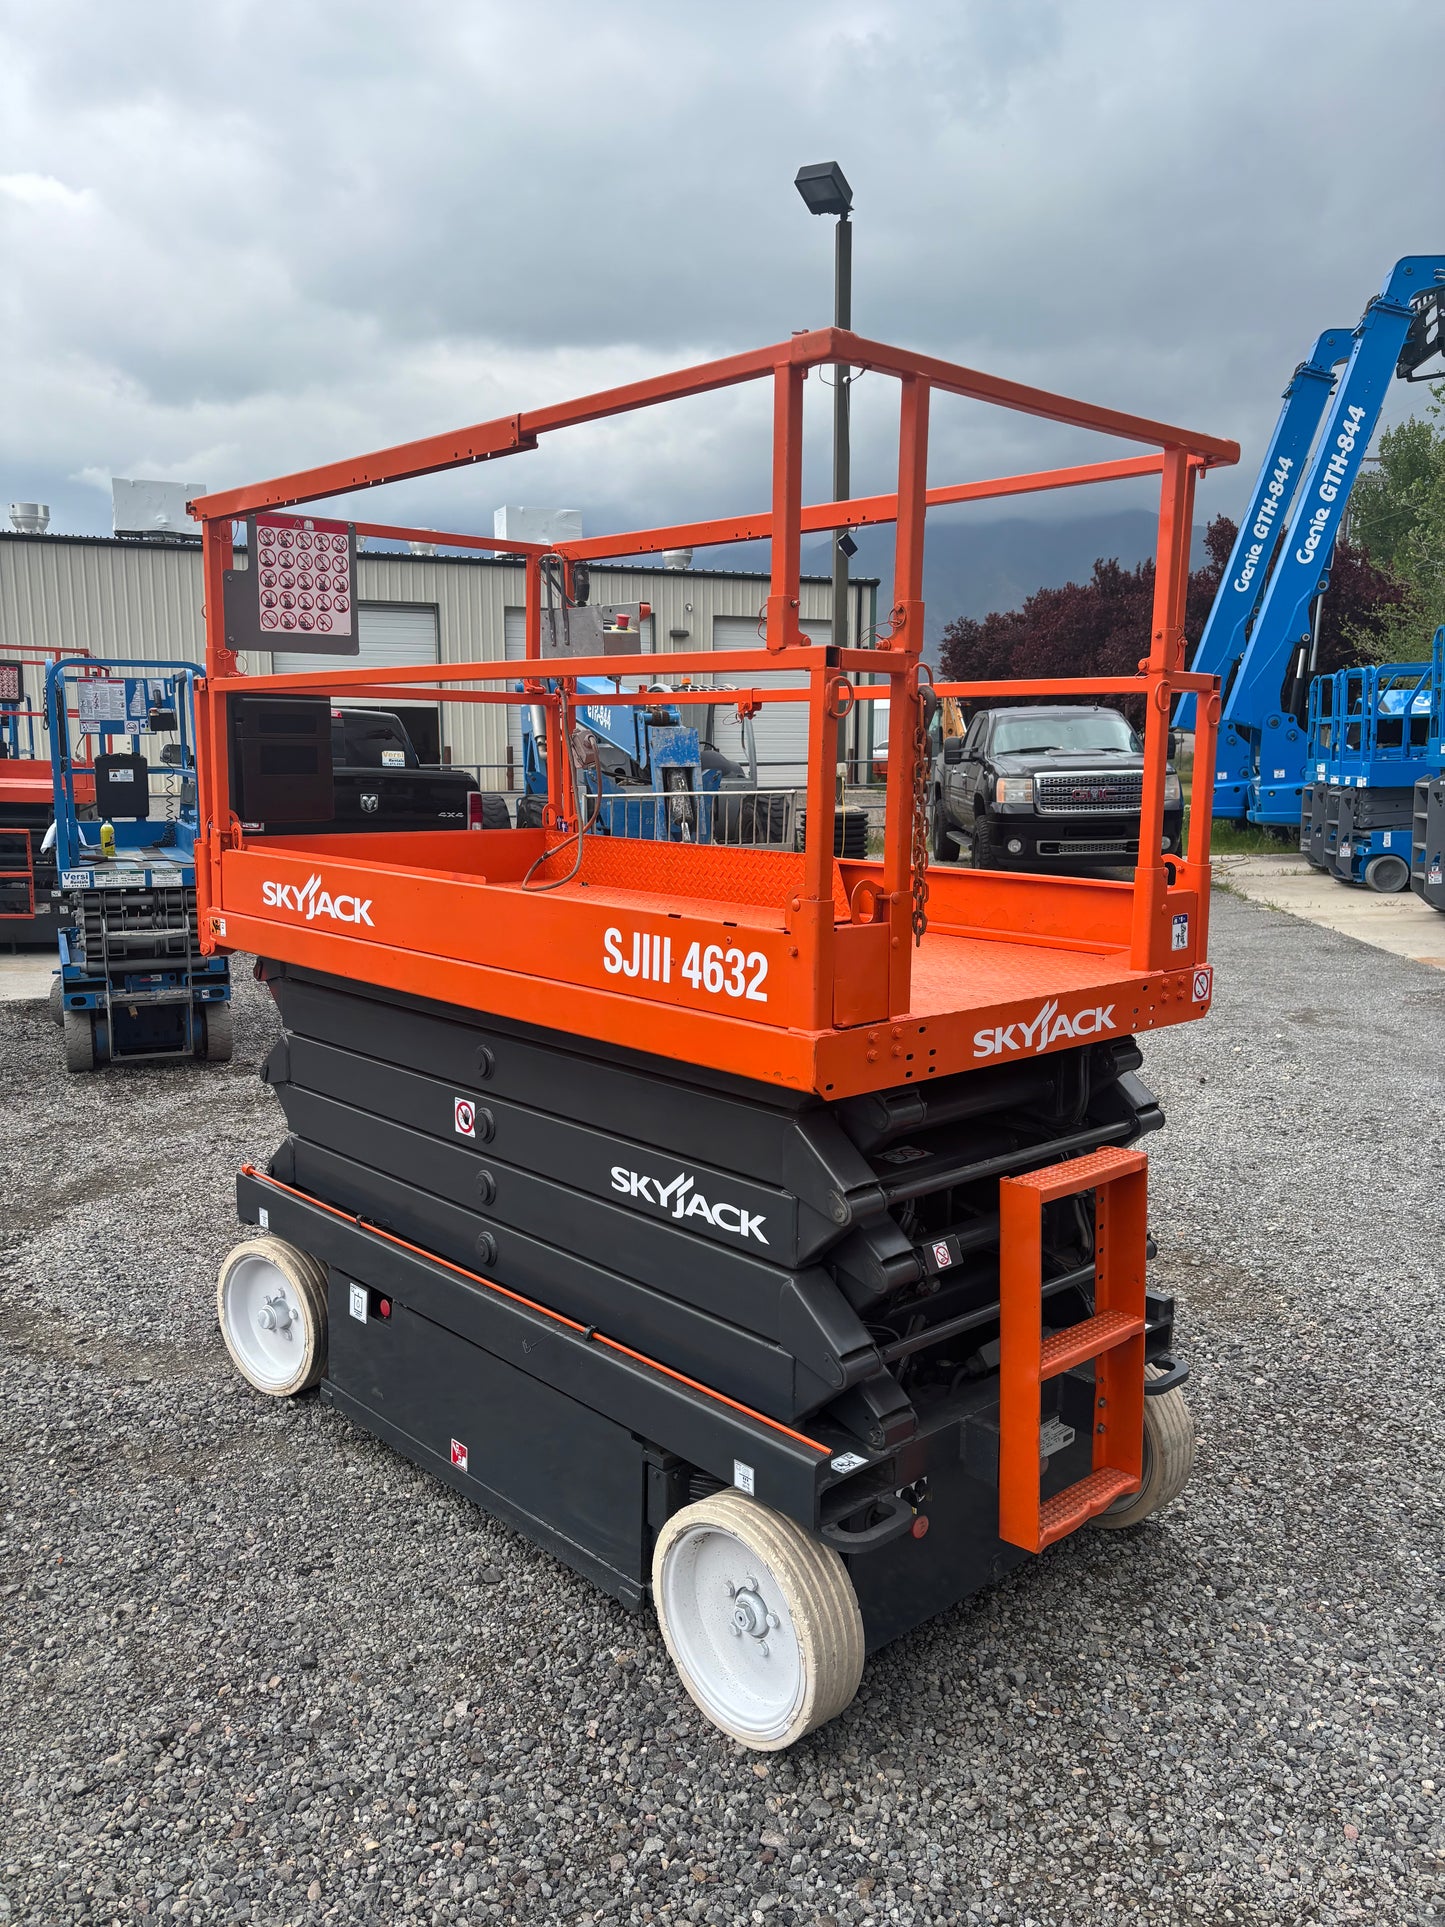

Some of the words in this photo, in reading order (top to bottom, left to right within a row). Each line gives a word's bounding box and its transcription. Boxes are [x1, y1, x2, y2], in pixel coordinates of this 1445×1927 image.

[1296, 508, 1330, 564] Genie
[1319, 404, 1366, 502] GTH-844
[1234, 544, 1262, 592] Genie
[1253, 456, 1294, 540] GTH-844
[262, 872, 375, 927] SKYJACK
[603, 927, 671, 983] SJIII
[681, 941, 769, 1003] 4632
[973, 998, 1117, 1058] SKYJACK
[610, 1166, 770, 1246] SKYJACK
